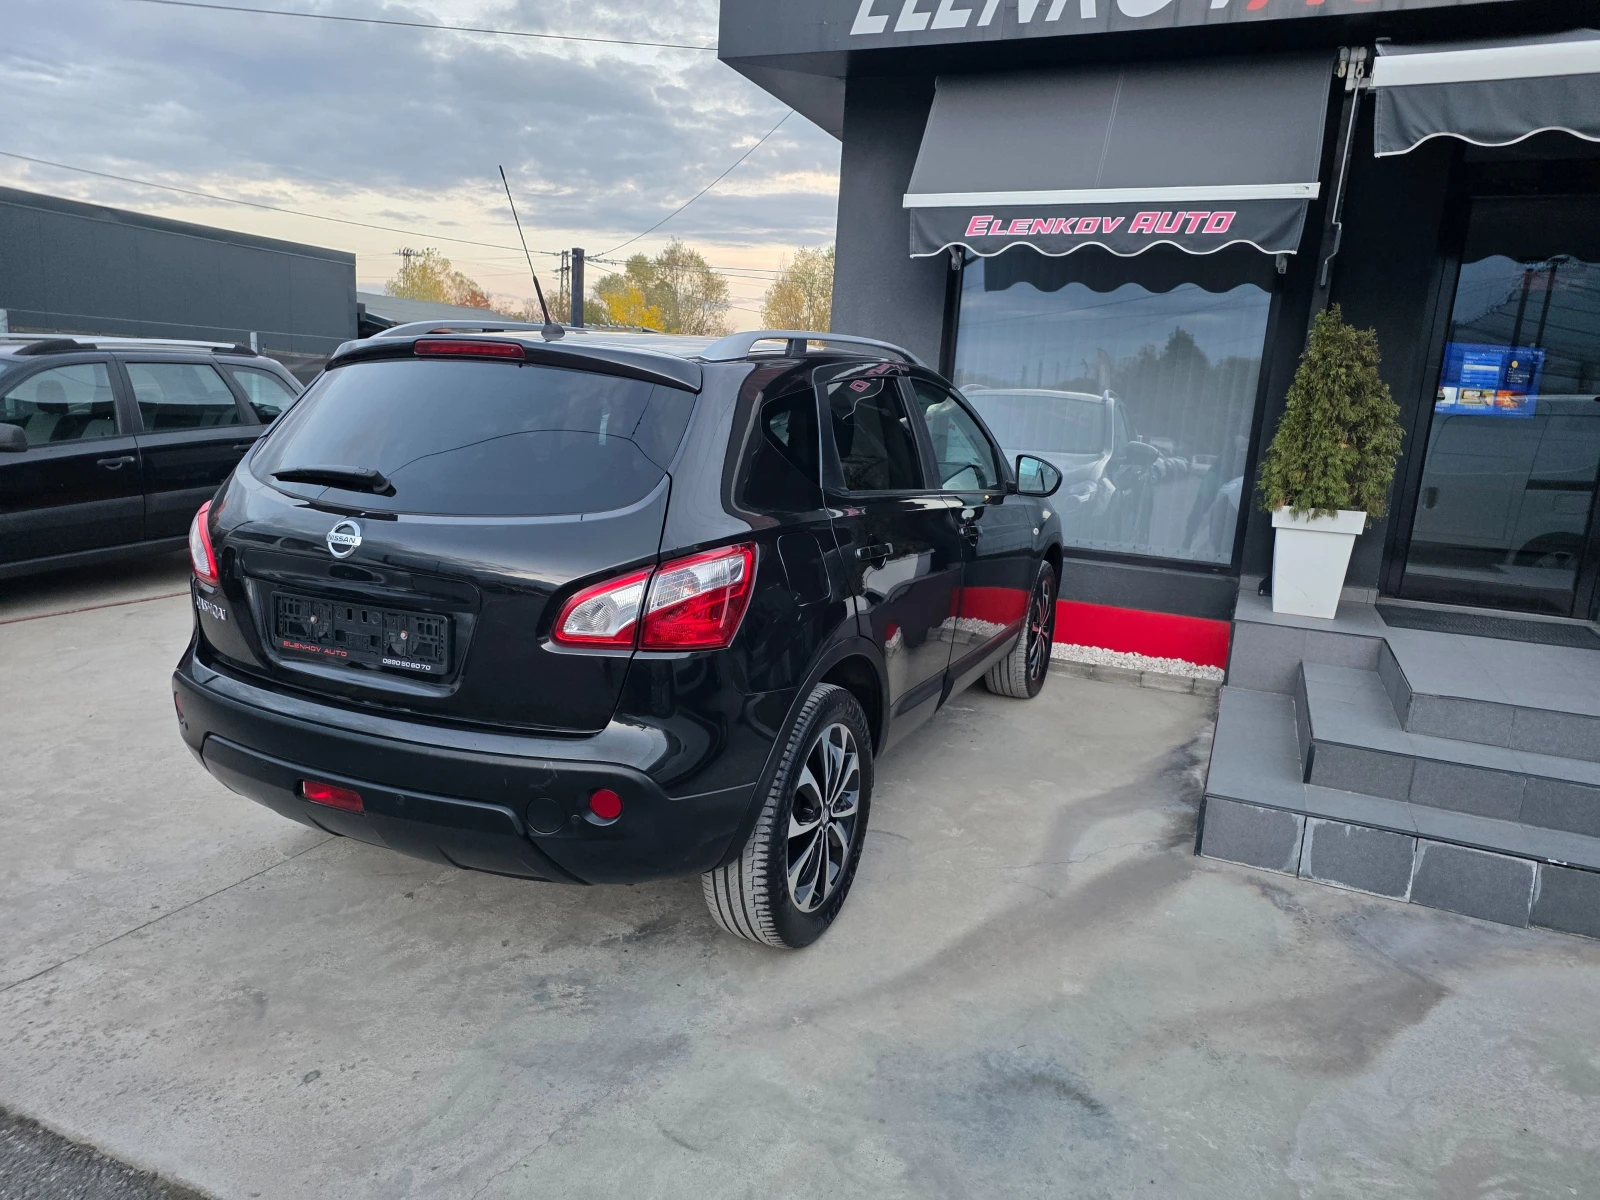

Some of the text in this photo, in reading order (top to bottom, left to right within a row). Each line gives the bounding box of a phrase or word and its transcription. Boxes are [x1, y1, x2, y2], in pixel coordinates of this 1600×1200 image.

[965, 211, 1236, 237] ELENKOV AUTO
[328, 533, 357, 545] NISSAN
[324, 648, 348, 658] AUTO
